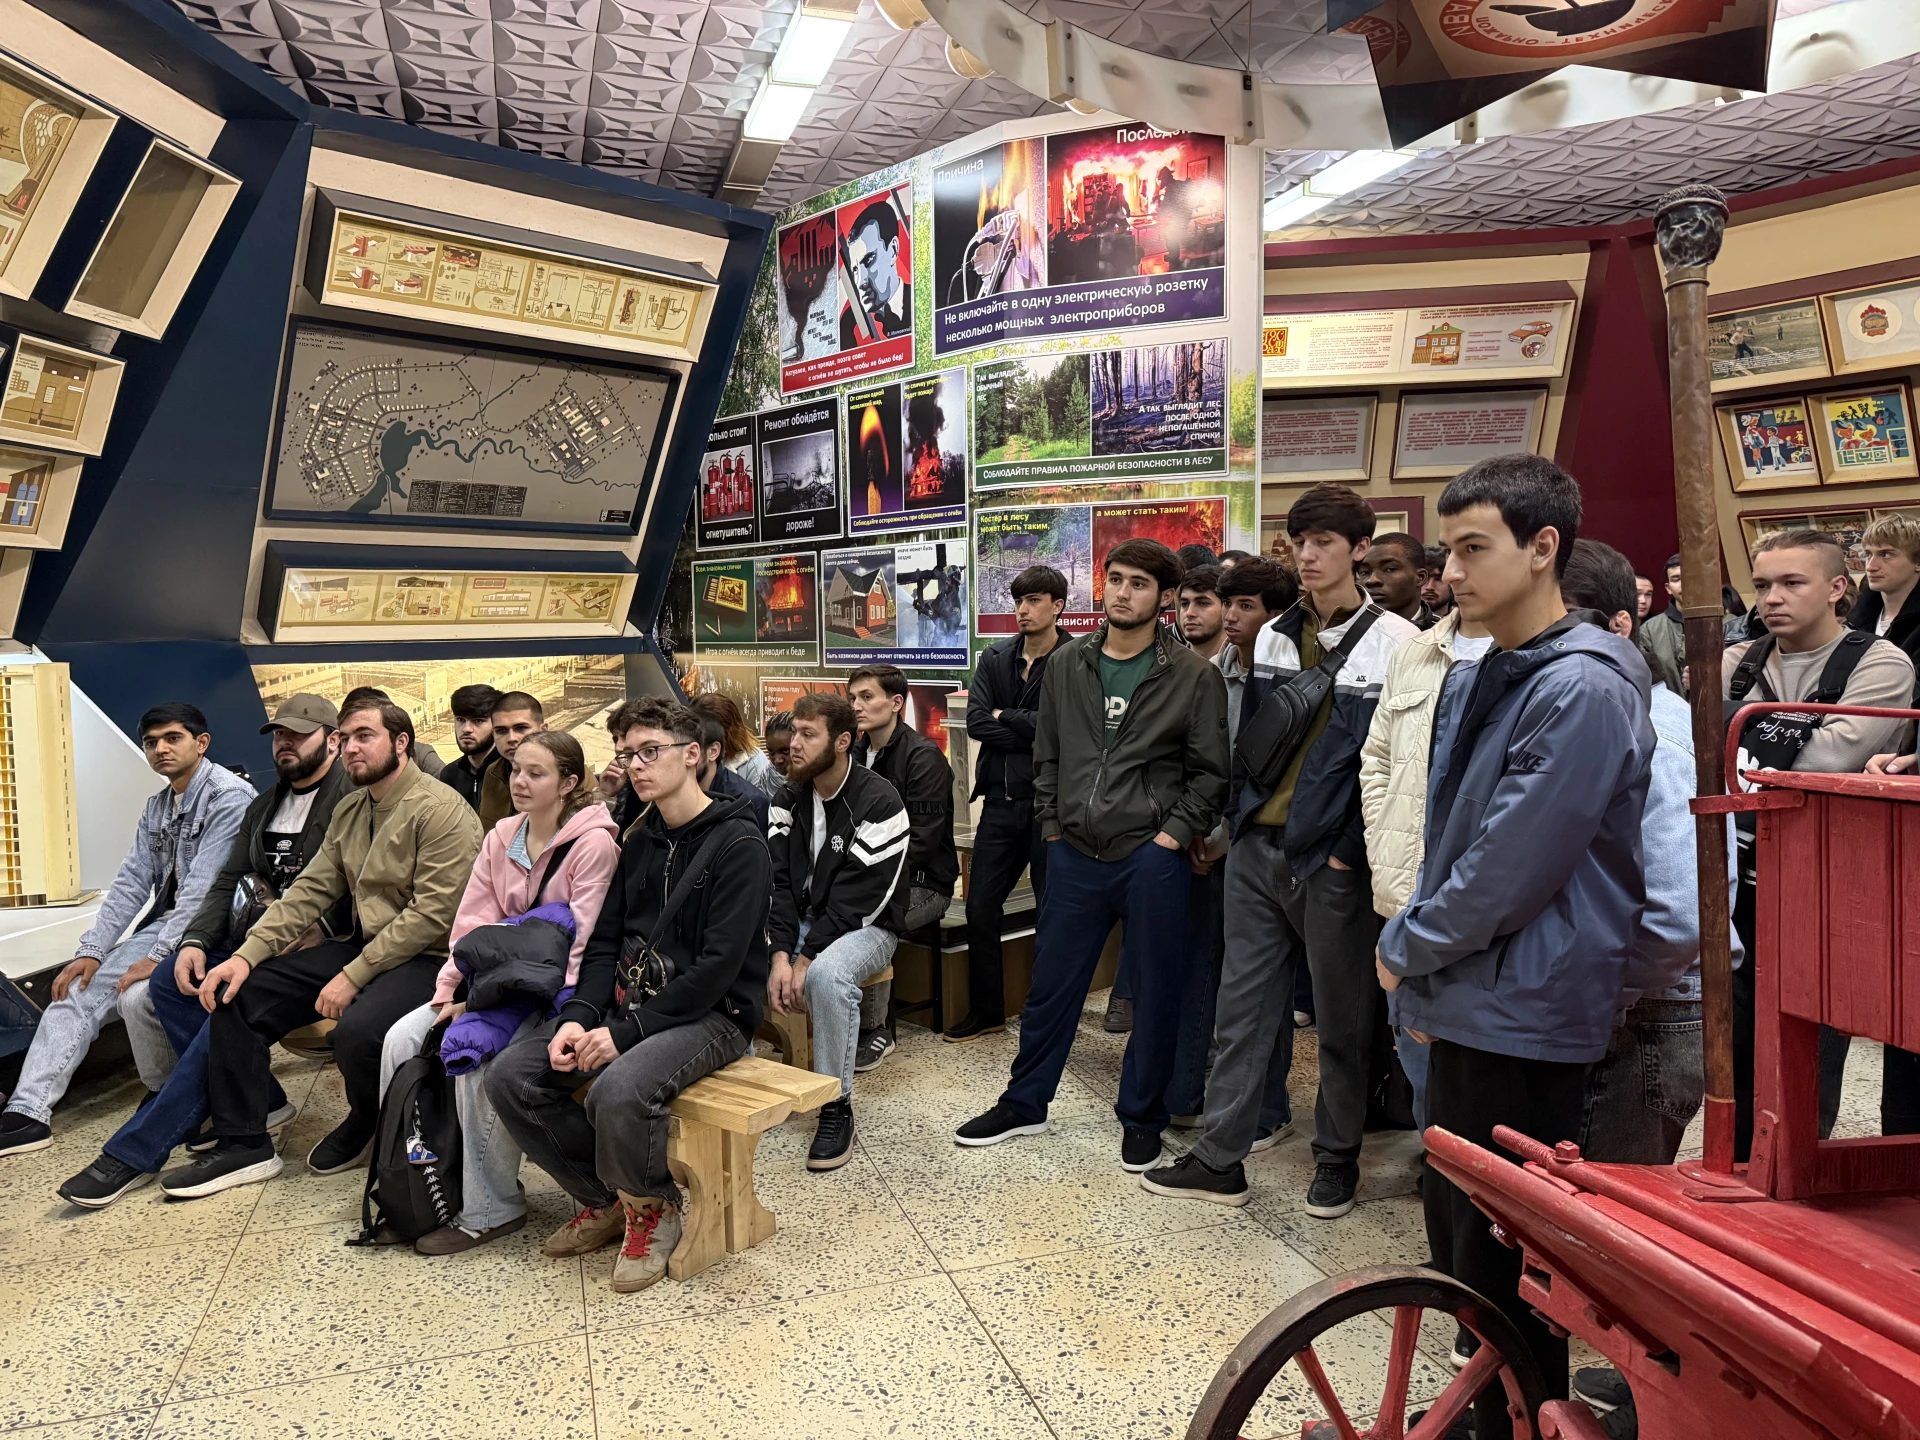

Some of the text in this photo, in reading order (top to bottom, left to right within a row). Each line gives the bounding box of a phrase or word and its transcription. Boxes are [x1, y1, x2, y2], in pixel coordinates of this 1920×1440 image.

[937, 159, 984, 184] Причина
[944, 275, 1209, 325] Не включайте в одну электрическую розетку
[946, 302, 1166, 344] несколько мощных электроприборов
[807, 364, 817, 372] как
[817, 359, 837, 369] прежде,
[852, 351, 867, 360] совет
[812, 372, 827, 381] огнём
[854, 361, 870, 370] чтобы
[878, 356, 892, 365] было
[892, 352, 904, 362] бед!
[1163, 401, 1204, 412] ВЫГЛЯДИТ
[1206, 400, 1222, 408] ЛЕС
[764, 409, 830, 432] Ремонт обойдётся
[1165, 409, 1221, 422] ПОСЛЕ ОДНОЙ
[708, 426, 748, 442] олько стоит
[1190, 432, 1221, 441] СПИЧКИ
[1031, 464, 1068, 475] ПРАВИЛА
[1069, 460, 1116, 472] ПОЖАРНОЙ
[1117, 457, 1183, 470] БЕЗОПАСНОСТИ
[1184, 457, 1191, 466] В
[1192, 455, 1214, 465] ЛЕСУ
[1010, 513, 1030, 522] лесу
[1104, 509, 1132, 517] может
[1133, 508, 1157, 516] стать
[1158, 504, 1189, 515] таким!
[786, 516, 815, 533] дороже!
[980, 522, 1051, 533] может быть таким,
[706, 524, 753, 541] огнетушитель?
[800, 565, 815, 574] огнём
[1055, 617, 1095, 626] ависит
[705, 647, 719, 658] Игра
[722, 647, 739, 658] огнём
[739, 648, 757, 657] всегда
[757, 648, 785, 658] приводит
[790, 646, 806, 657] беде
[930, 652, 966, 660] безопасность
